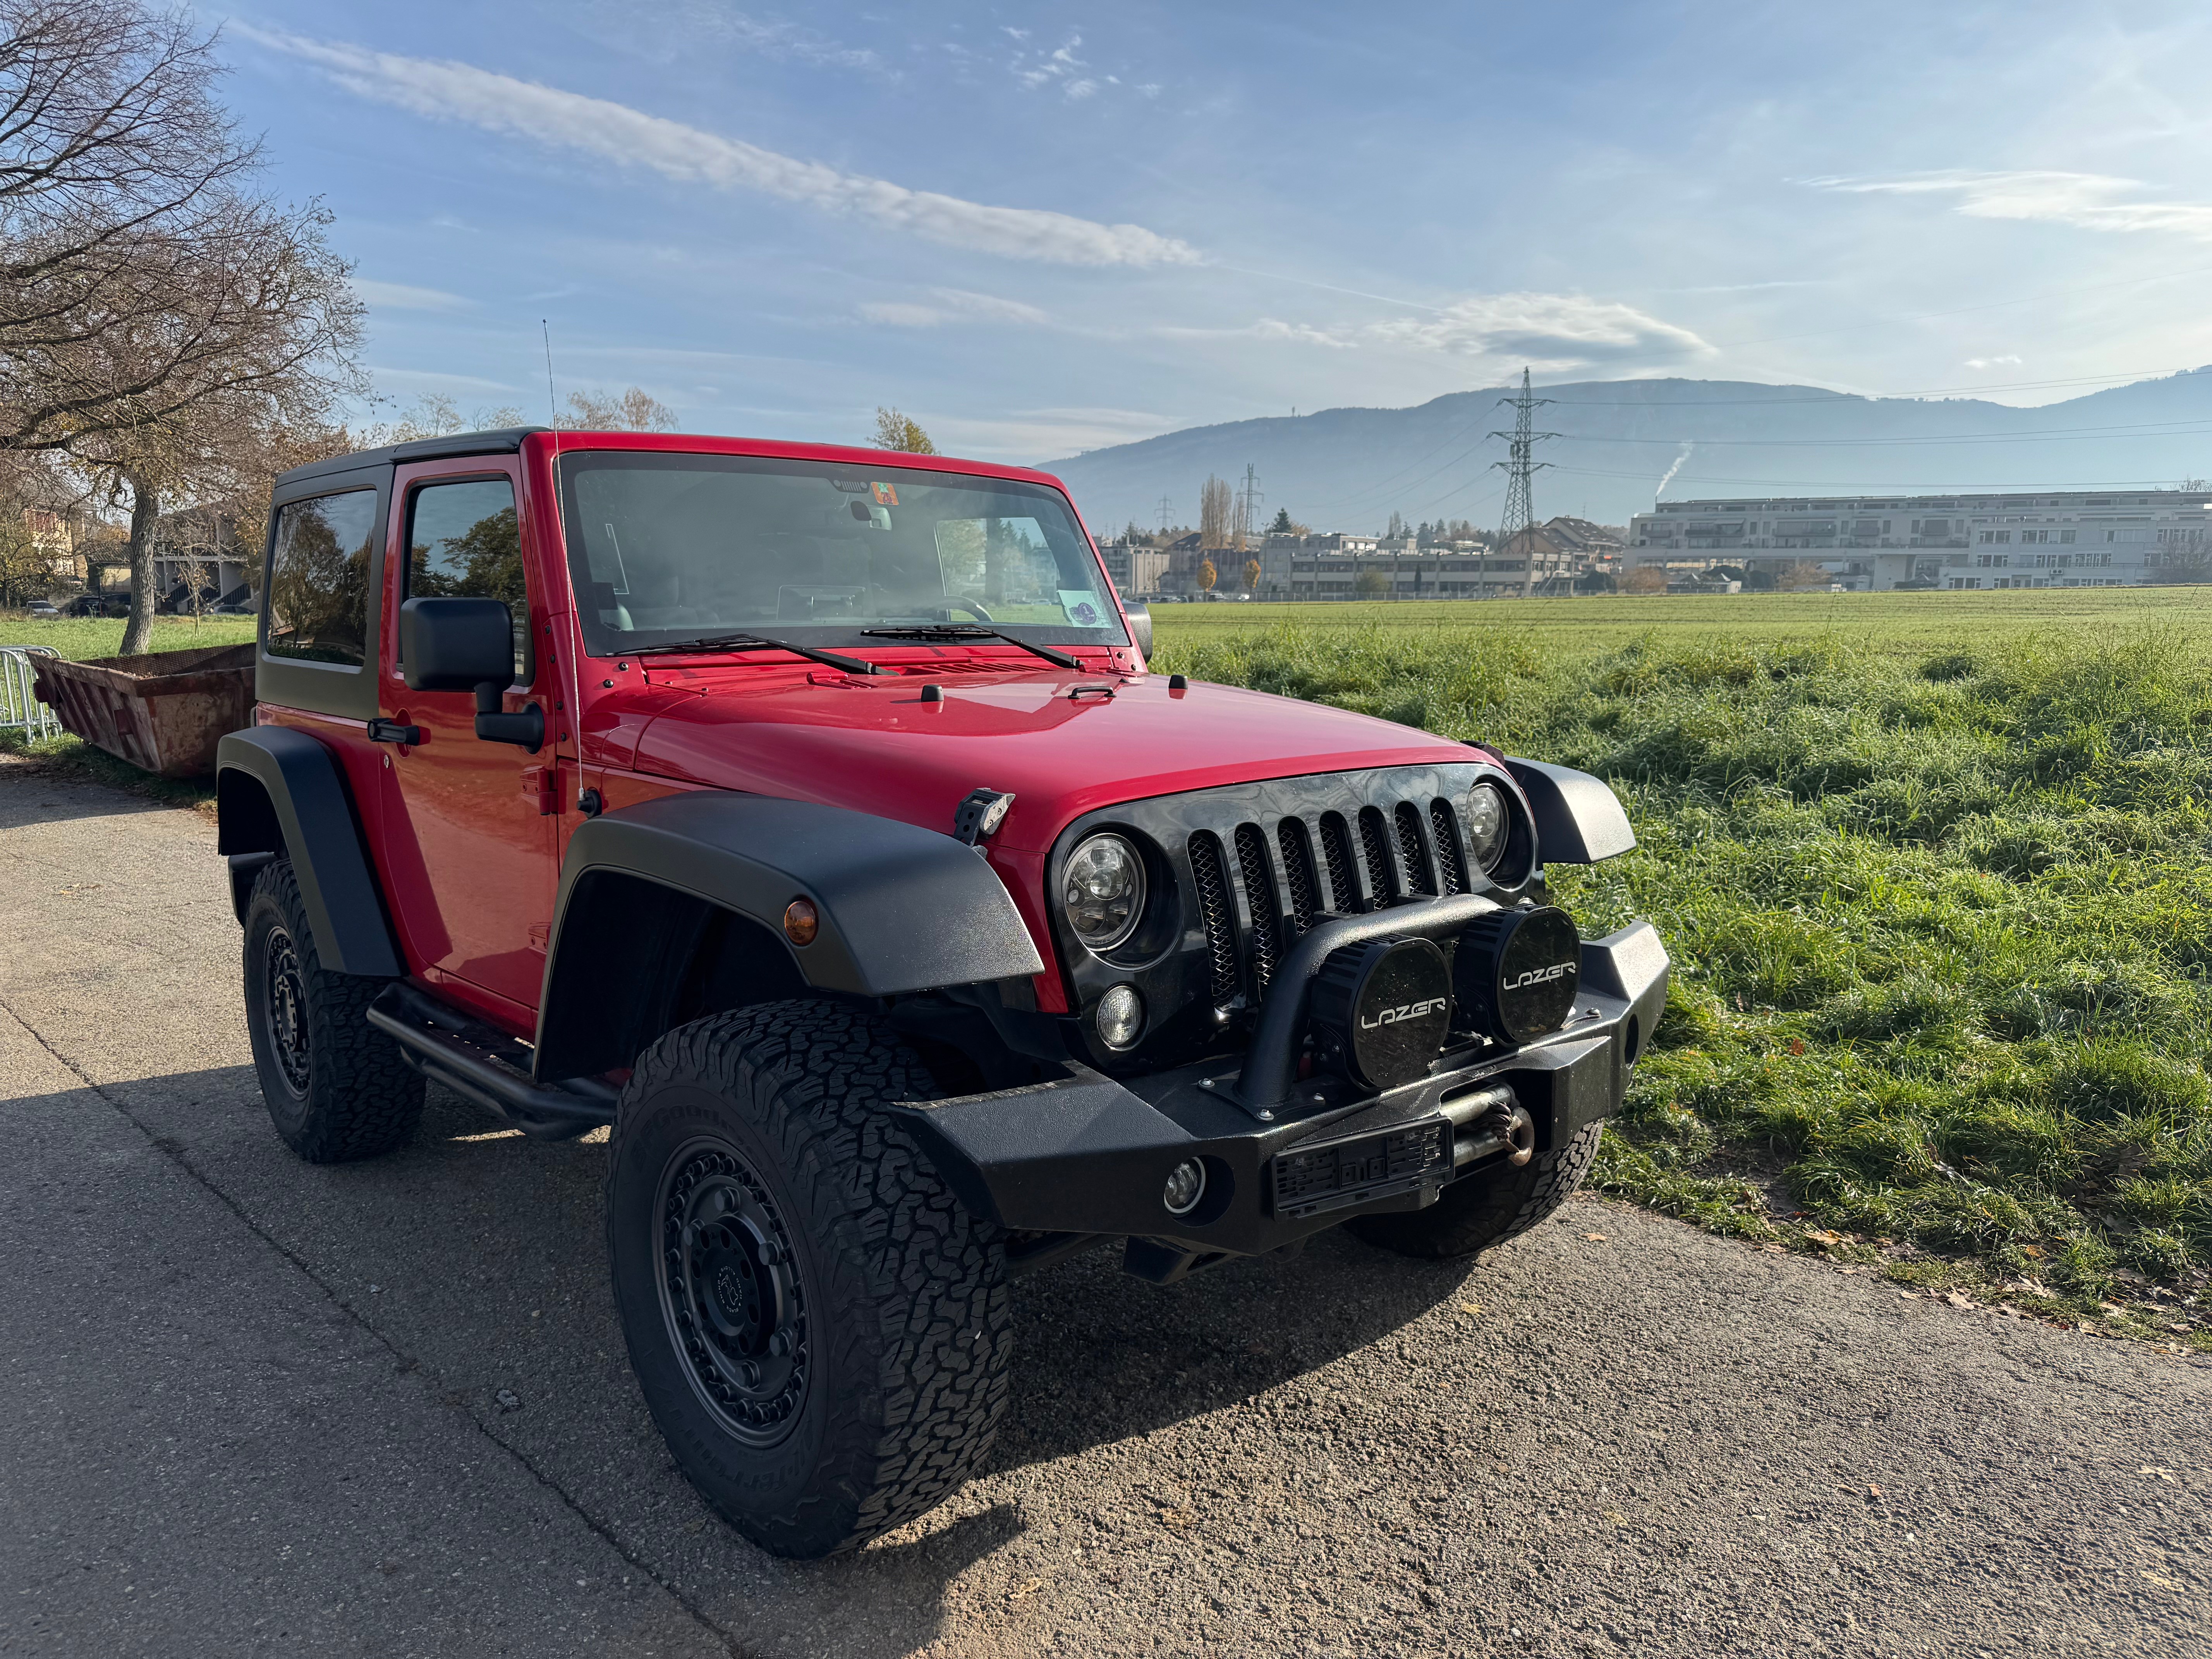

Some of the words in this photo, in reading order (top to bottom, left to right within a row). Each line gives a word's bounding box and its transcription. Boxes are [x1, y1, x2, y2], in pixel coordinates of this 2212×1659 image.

[1503, 962, 1575, 990] LAZER
[1361, 998, 1446, 1029] LAZER
[721, 1266, 735, 1275] ALLOYS
